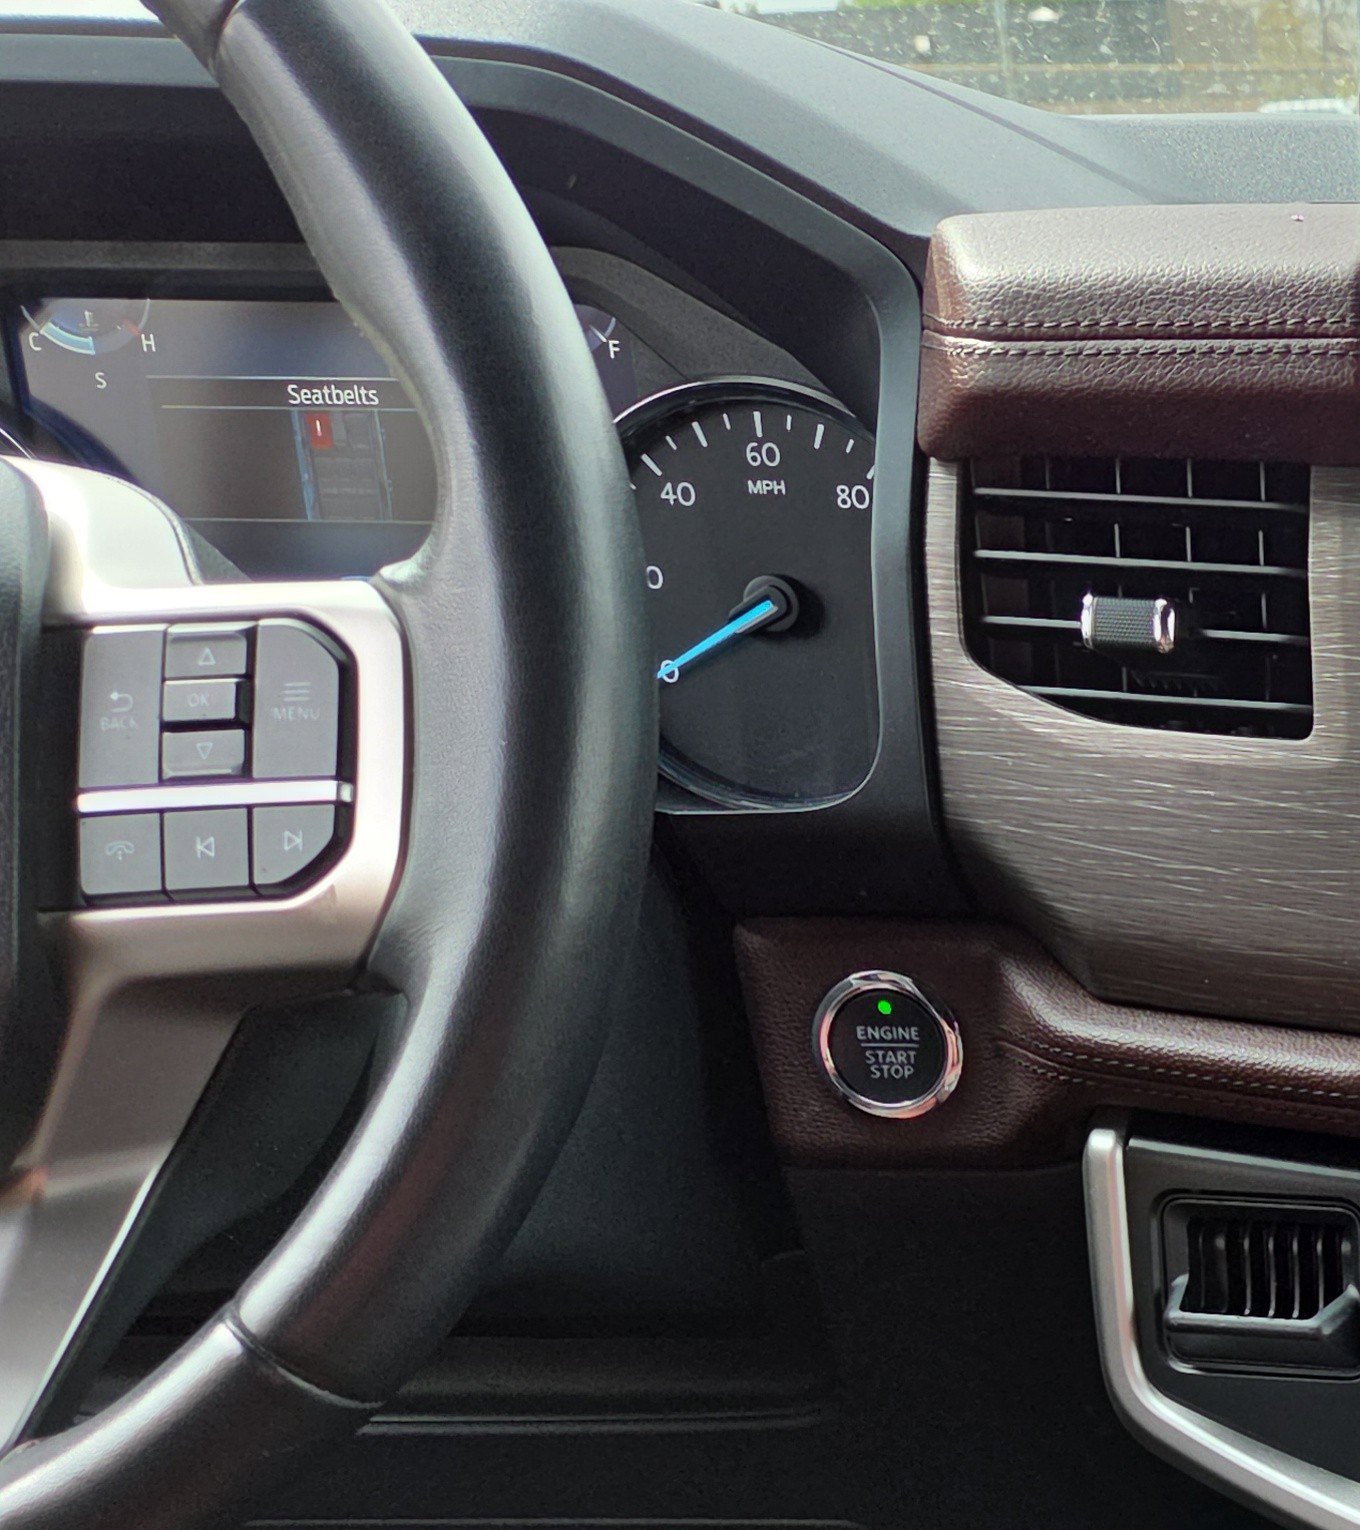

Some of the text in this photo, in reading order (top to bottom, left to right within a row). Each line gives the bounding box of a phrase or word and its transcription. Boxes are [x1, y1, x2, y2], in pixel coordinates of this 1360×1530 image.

[28, 332, 43, 353] C
[141, 332, 156, 353] H
[607, 339, 621, 359] F
[94, 372, 108, 390] S
[287, 384, 380, 406] Seatbelts
[745, 441, 781, 467] 60
[660, 481, 697, 507] 40
[747, 479, 786, 496] MPH
[835, 484, 870, 509] 80
[187, 693, 210, 707] OK
[271, 707, 321, 721] MENU
[101, 716, 138, 731] BACK
[856, 1025, 920, 1041] ENGINE
[865, 1050, 917, 1065] START
[870, 1064, 914, 1080] STOP
